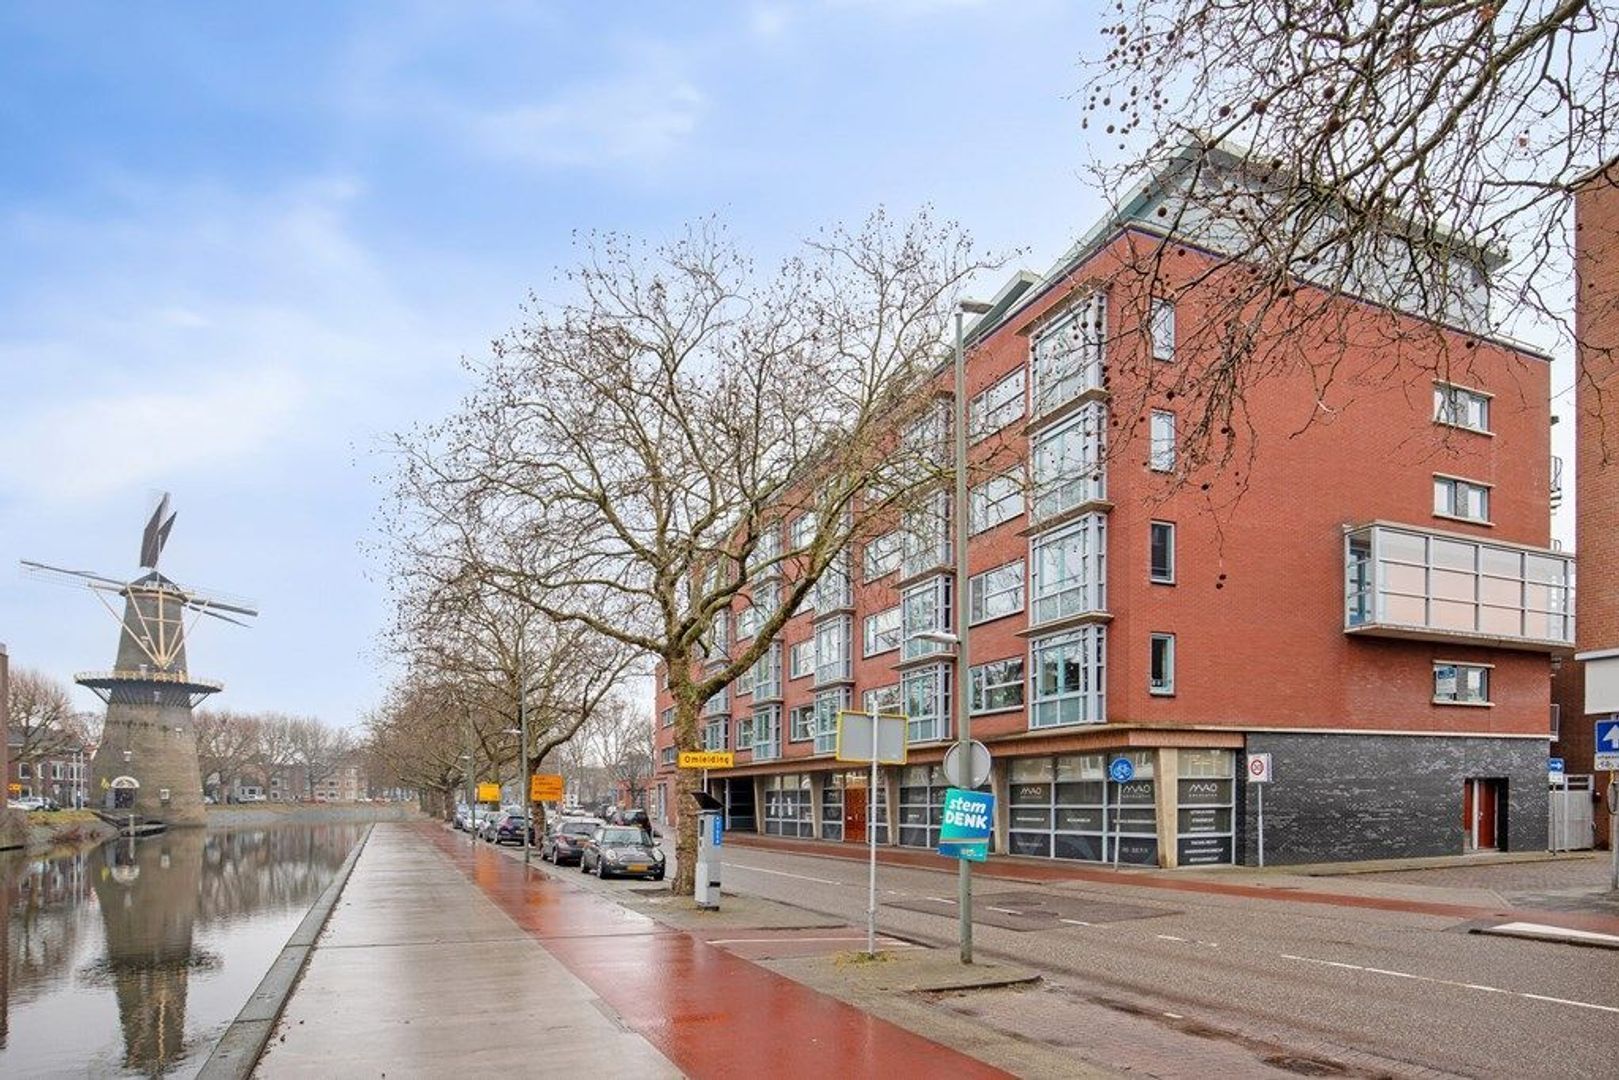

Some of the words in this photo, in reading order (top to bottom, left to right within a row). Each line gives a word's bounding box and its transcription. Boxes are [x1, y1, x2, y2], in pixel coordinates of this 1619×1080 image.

[684, 755, 730, 765] Omleiding
[1189, 783, 1217, 792] MAO
[949, 797, 986, 814] stem
[945, 810, 988, 829] DENK
